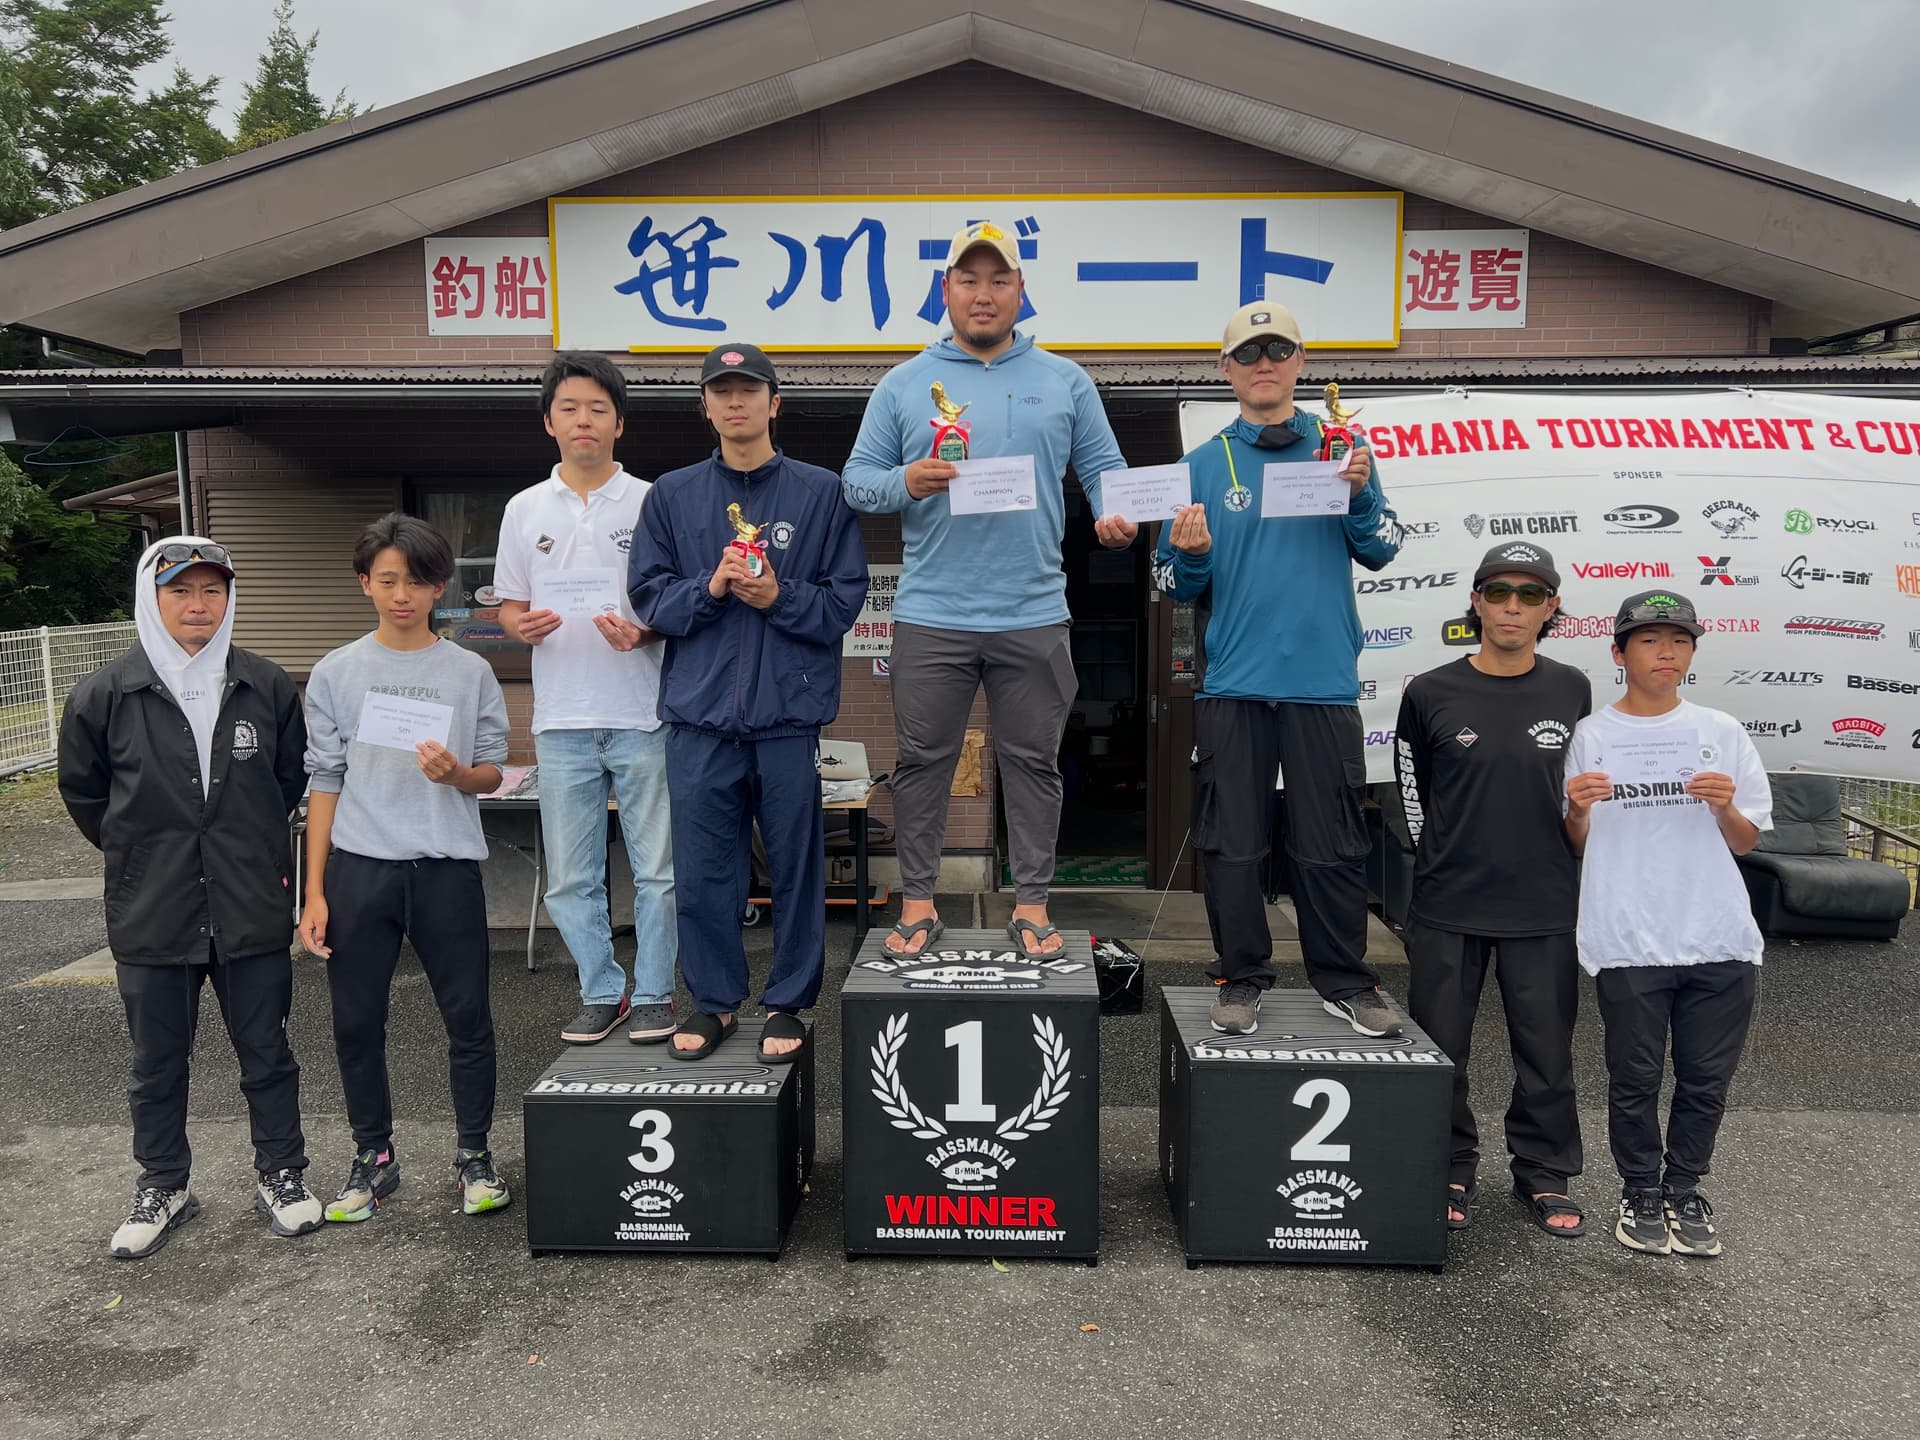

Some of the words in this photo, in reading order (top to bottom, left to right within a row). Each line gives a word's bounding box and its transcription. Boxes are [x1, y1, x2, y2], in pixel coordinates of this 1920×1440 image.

[1405, 248, 1523, 312] 遊覧
[432, 256, 547, 319] 釣船
[1363, 419, 1529, 458] SMANIA
[1537, 418, 1815, 450] TOURNAMENT
[1826, 423, 1856, 450] &
[1613, 471, 1663, 479] SPONSER
[973, 487, 1013, 497] CHAMPION
[1299, 492, 1314, 500] 2nd
[1131, 498, 1145, 506] BIG
[1702, 500, 1760, 521] GEECRACK
[1490, 518, 1523, 535] GAN
[1527, 516, 1578, 534] CRAFT
[1816, 517, 1875, 530] RYUGI
[1703, 566, 1728, 574] metal
[1735, 575, 1760, 585] Kanji
[1717, 619, 1760, 632] STAR
[1804, 630, 1855, 639] PERFORMANCE
[370, 685, 441, 699] GRATEFUL
[1527, 720, 1571, 739] BASSMANIA
[1834, 719, 1883, 735] MAGBITE
[1623, 801, 1655, 809] ORIGINAL
[1655, 798, 1685, 807] FISHING
[1686, 797, 1703, 805] CLUB
[1193, 1046, 1440, 1064] bassmania
[944, 1020, 996, 1122] 1
[531, 1080, 768, 1095] bassmania
[1290, 1078, 1351, 1162] 2
[627, 1109, 675, 1174] 3
[925, 1137, 1017, 1171] BASSMANIA
[619, 1178, 685, 1203] BASSMANIA
[1275, 1169, 1363, 1201] BASSMANIA
[885, 1194, 1058, 1227] WINNER
[620, 1223, 684, 1232] BASSMANIA
[876, 1227, 961, 1240] BASSMANIA
[965, 1228, 1066, 1241] TOURNAMENT
[1274, 1227, 1361, 1239] BASSMANIA
[614, 1232, 691, 1241] TOURNAMENT
[1267, 1238, 1369, 1251] TOURNAMENT
